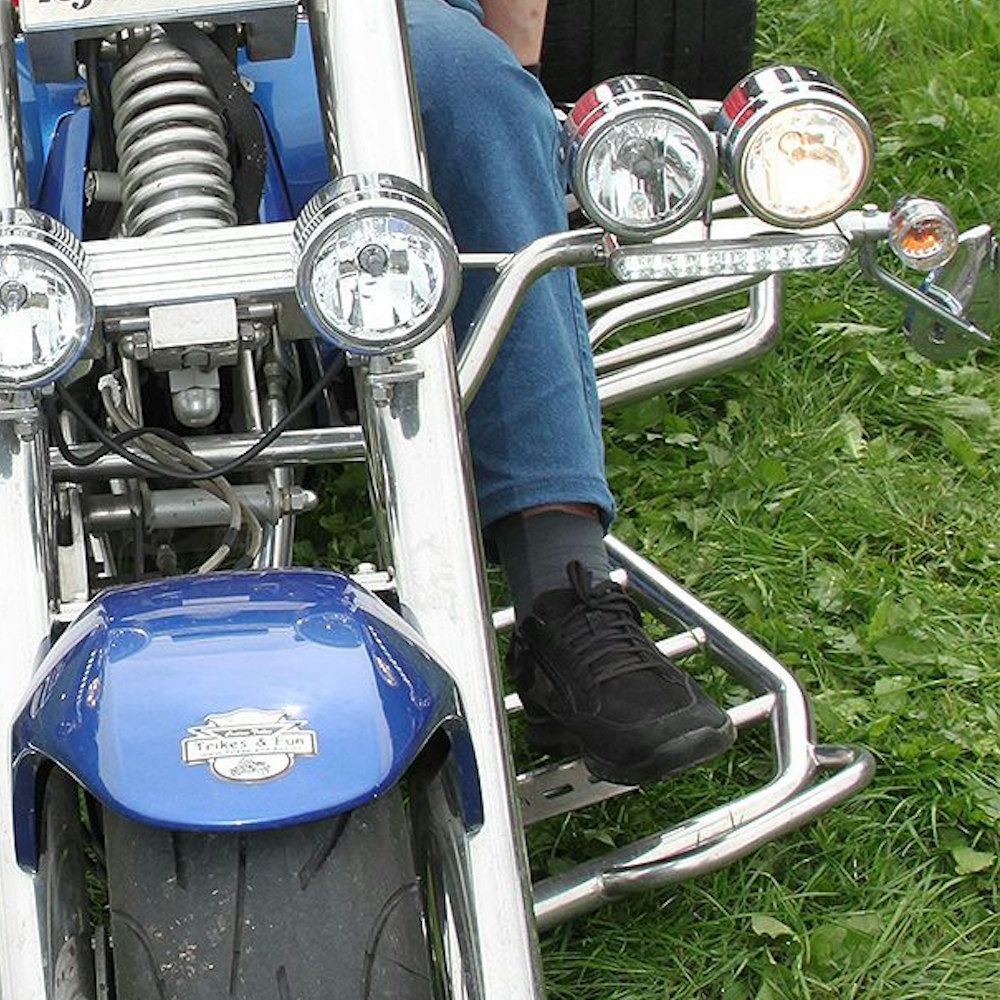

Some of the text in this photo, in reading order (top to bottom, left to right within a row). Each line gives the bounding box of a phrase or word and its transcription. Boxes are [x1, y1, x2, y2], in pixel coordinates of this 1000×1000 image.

[196, 736, 305, 751] Trikes & Fun
